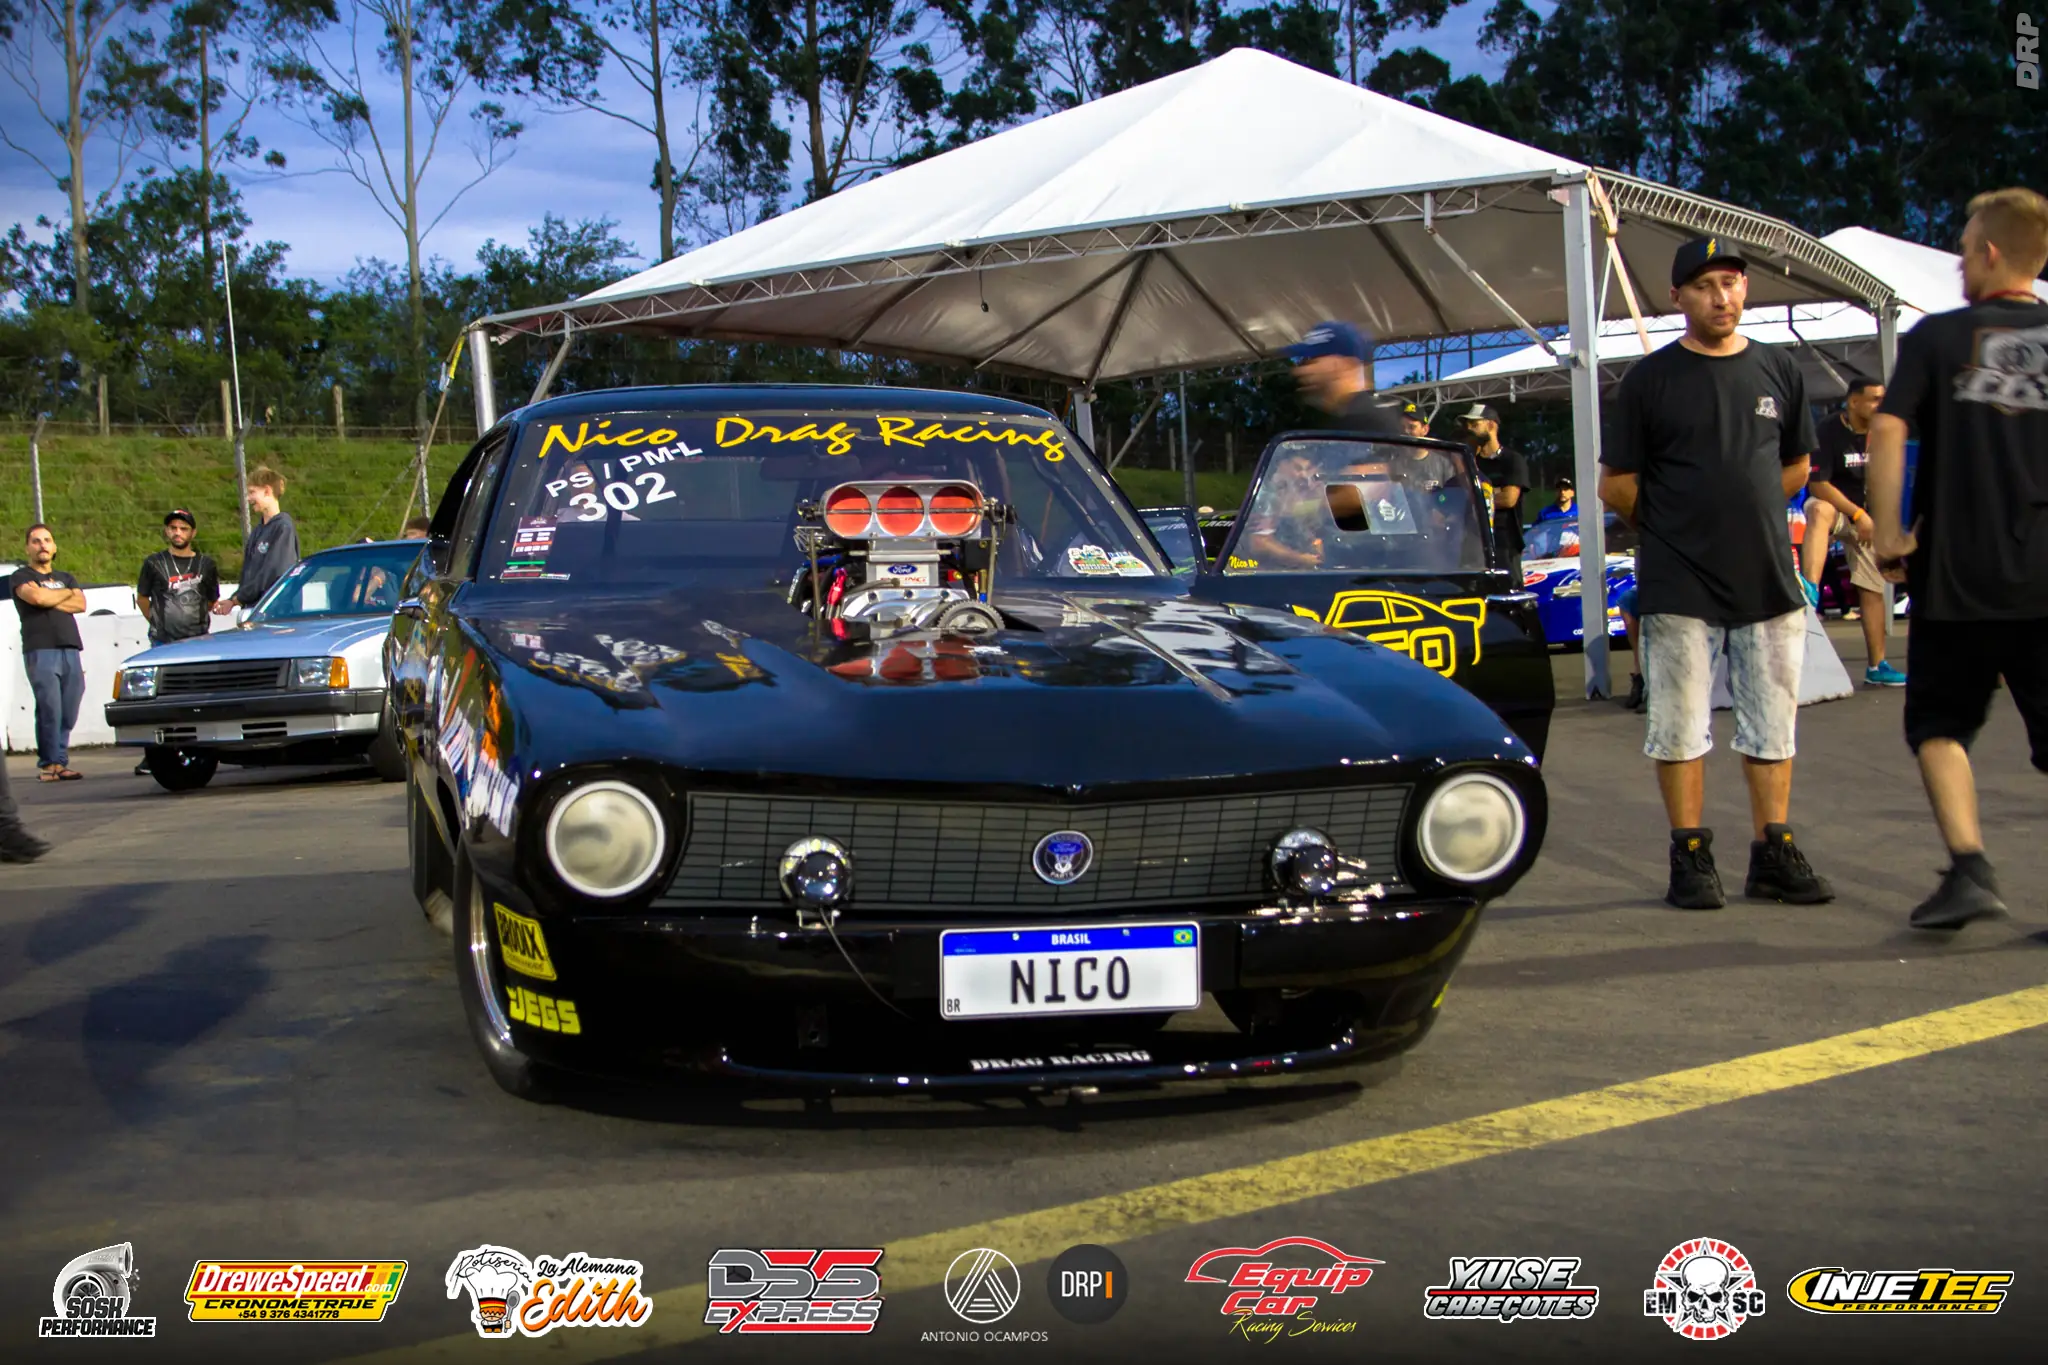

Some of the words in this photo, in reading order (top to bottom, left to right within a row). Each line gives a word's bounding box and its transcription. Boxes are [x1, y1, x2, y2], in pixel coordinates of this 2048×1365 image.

[538, 420, 678, 458] Nico
[716, 417, 856, 455] Drag
[877, 417, 1065, 462] Racing
[545, 472, 594, 498] PS
[619, 441, 703, 473] PM-L
[569, 472, 677, 522] 302
[892, 564, 913, 574] Ford
[1051, 933, 1091, 945] BRASIL
[1010, 956, 1131, 1005] NICO
[506, 986, 582, 1034] JEGS
[947, 999, 961, 1013] BR
[970, 1058, 1044, 1071] DRAG
[1049, 1050, 1151, 1065] RACING
